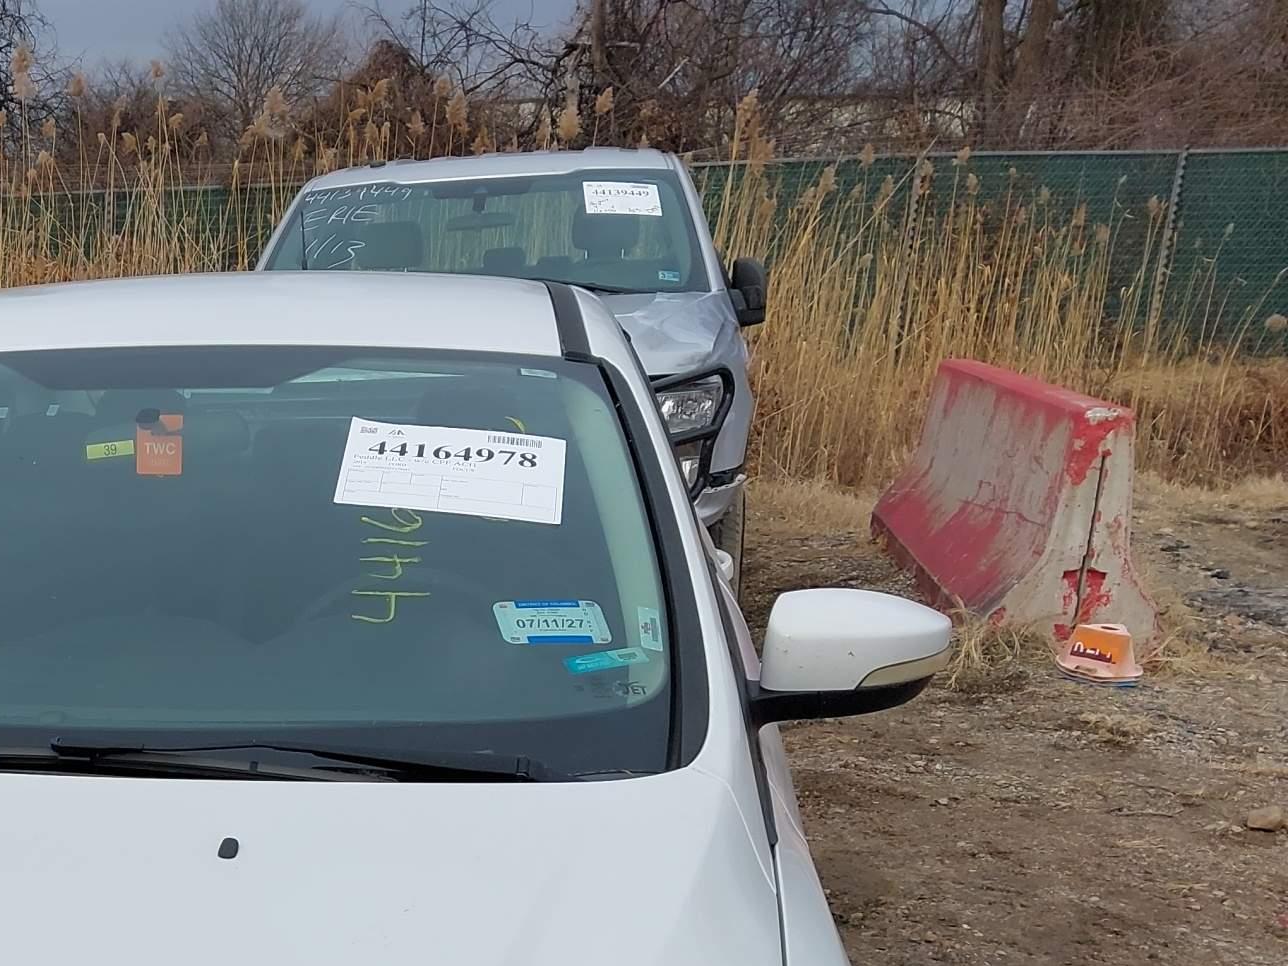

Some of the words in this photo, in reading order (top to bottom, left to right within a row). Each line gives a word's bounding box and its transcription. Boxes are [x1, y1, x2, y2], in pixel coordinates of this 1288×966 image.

[301, 204, 379, 232] ERIE
[103, 444, 117, 456] 39
[143, 442, 177, 455] TWC
[368, 440, 538, 468] 44164978
[516, 618, 584, 629] 07/11/27
